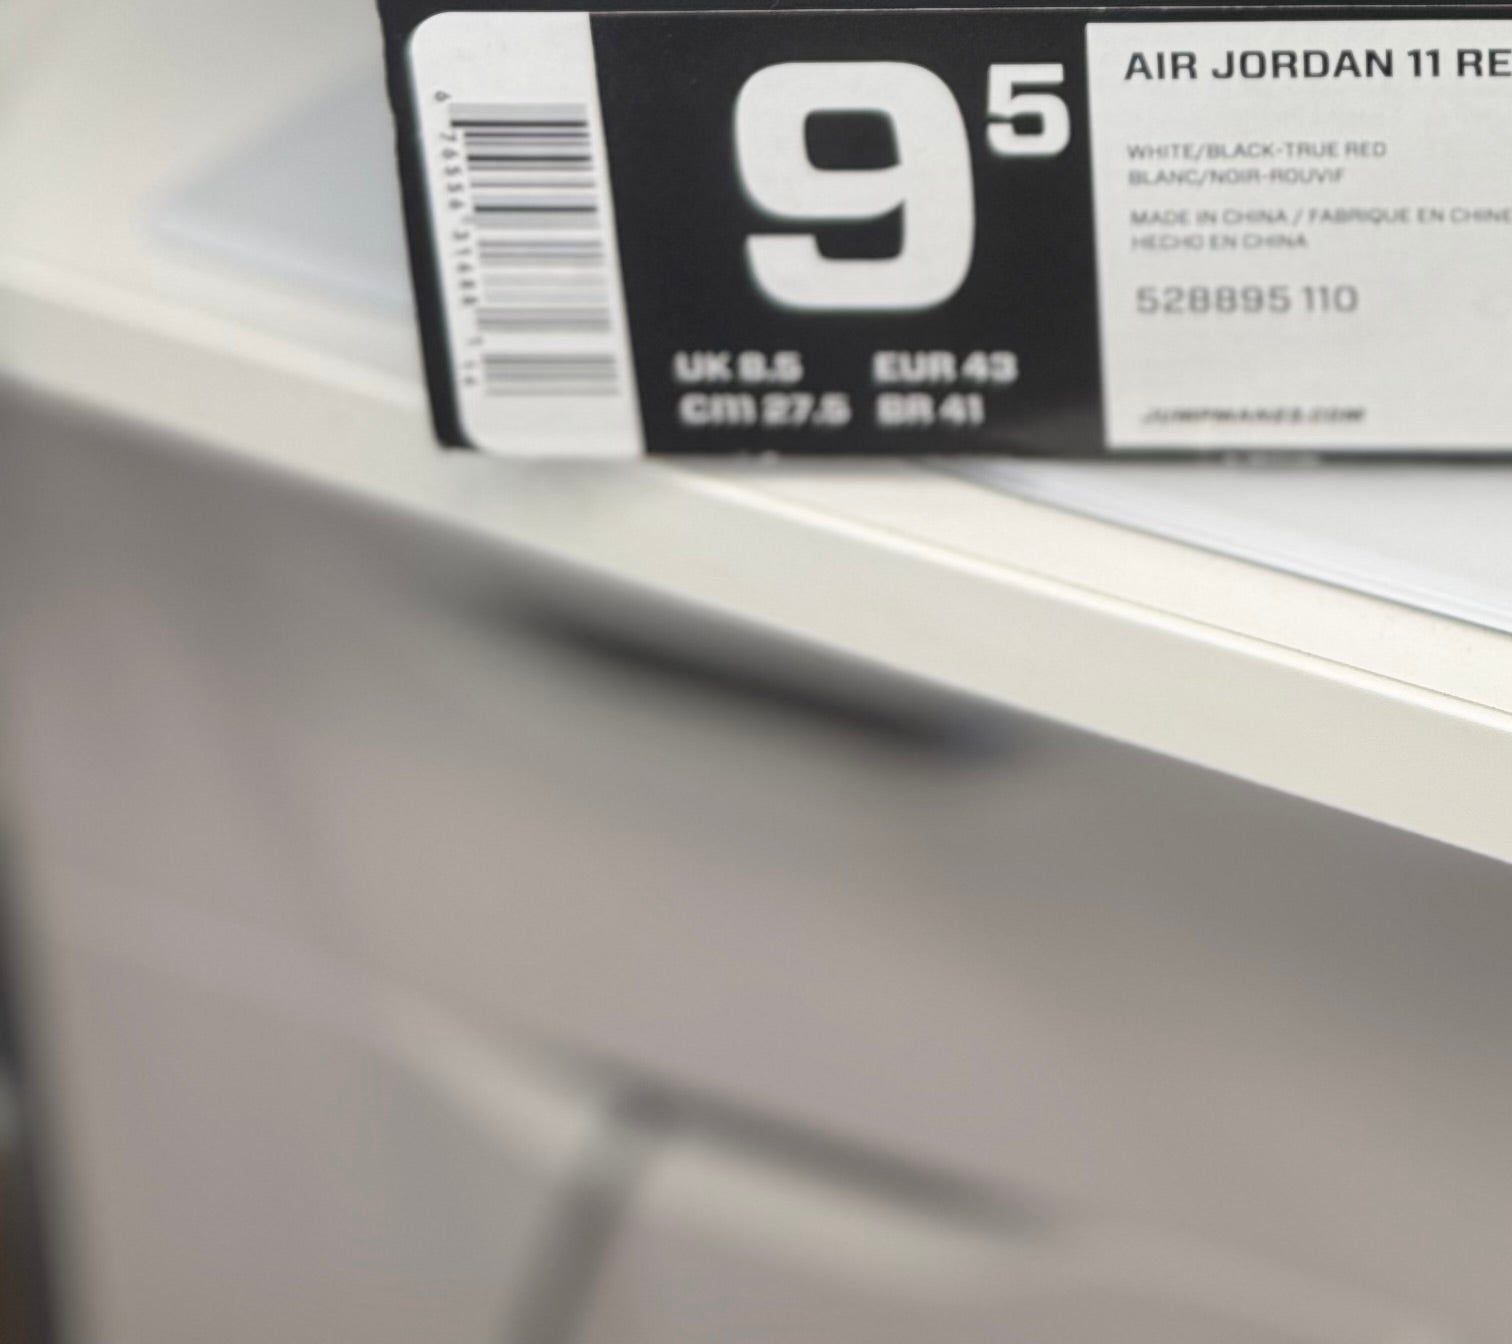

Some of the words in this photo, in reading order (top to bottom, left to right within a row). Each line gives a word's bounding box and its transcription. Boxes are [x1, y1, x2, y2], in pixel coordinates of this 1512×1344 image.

[1124, 50, 1198, 80] AIR
[1211, 48, 1394, 79] JORDAN
[1407, 48, 1440, 77] 11
[1126, 142, 1339, 161] WHITE/BLACK-TRUE
[1344, 142, 1387, 158] RED
[733, 60, 976, 312] 9
[985, 62, 1071, 157] 5
[1130, 209, 1191, 226] MADE
[1196, 209, 1218, 226] IN
[1222, 209, 1288, 226] CHINA
[1308, 208, 1411, 226] FABRIQUE
[1416, 208, 1444, 224] EN
[1130, 234, 1205, 251] HECHO
[1210, 234, 1238, 250] EN
[1242, 234, 1308, 250] CHINA
[1135, 285, 1292, 314] 528895
[1301, 284, 1359, 313] 110
[674, 350, 732, 383] UK
[872, 350, 957, 383] EUR
[961, 350, 1019, 383] 43
[762, 392, 852, 426] 27.5
[938, 392, 985, 426] 41
